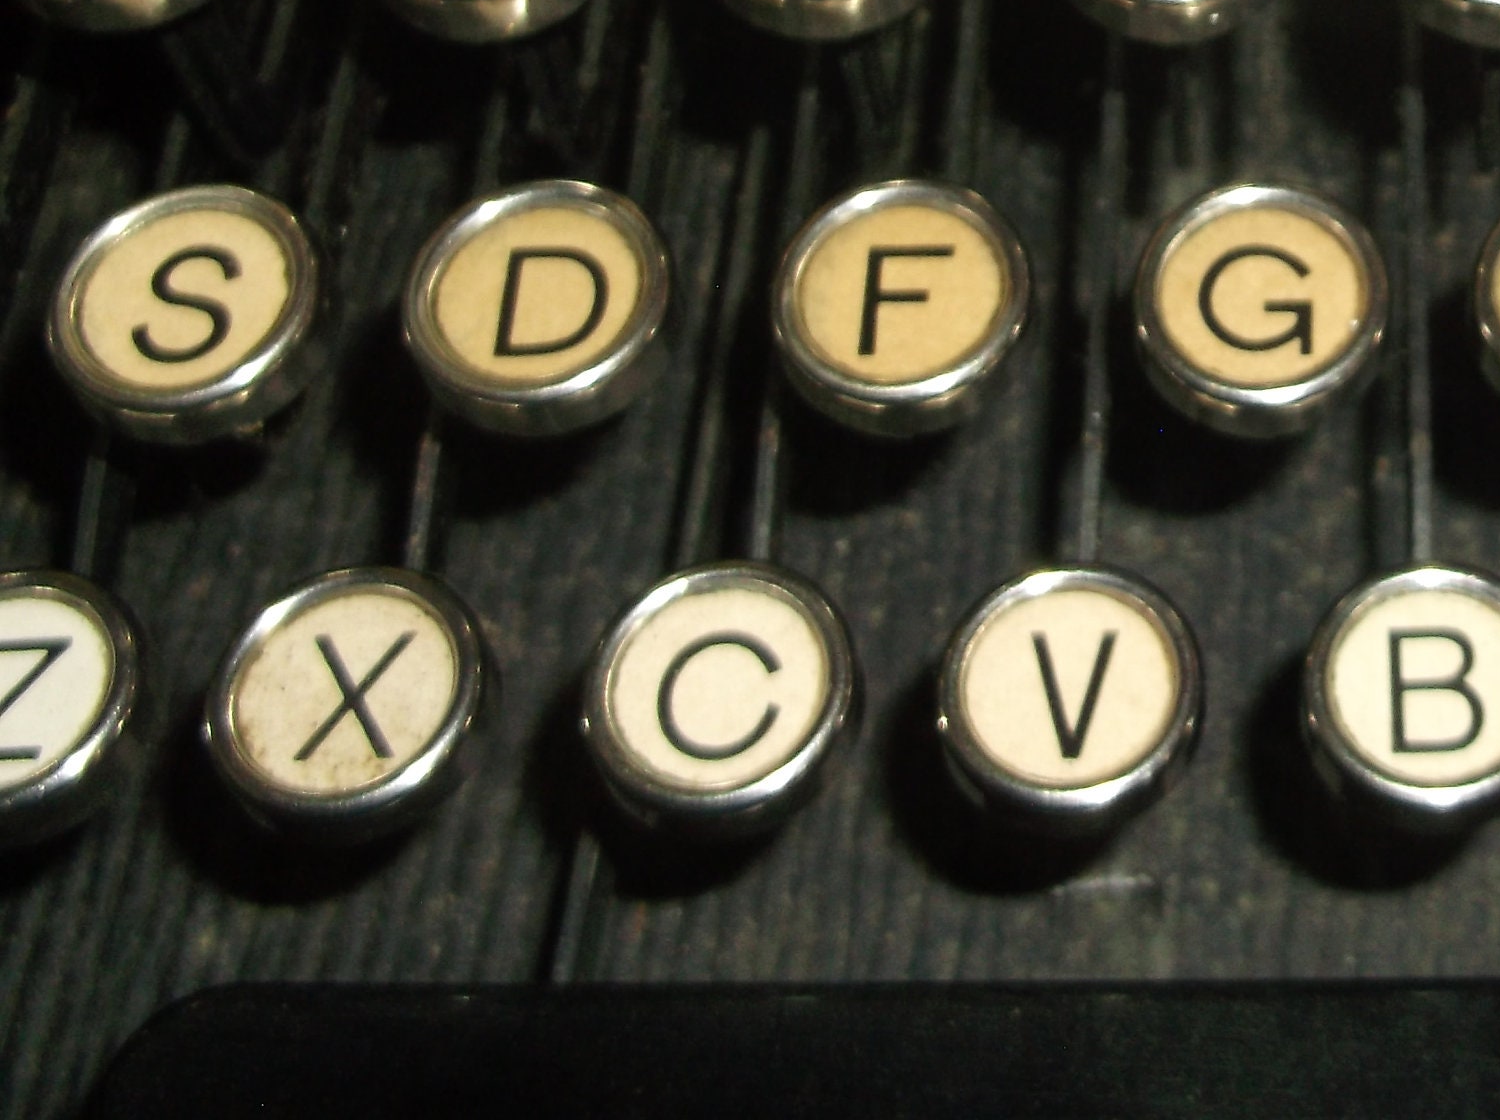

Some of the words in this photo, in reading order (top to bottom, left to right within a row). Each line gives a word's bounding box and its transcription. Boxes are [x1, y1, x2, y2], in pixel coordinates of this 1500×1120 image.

[131, 246, 240, 364] S
[493, 247, 609, 357] D
[858, 245, 954, 356] F
[1198, 245, 1313, 355] G
[0, 637, 73, 761] Z
[294, 633, 414, 761] X
[657, 632, 780, 761] C
[1033, 633, 1116, 759] V
[1389, 628, 1484, 754] B
